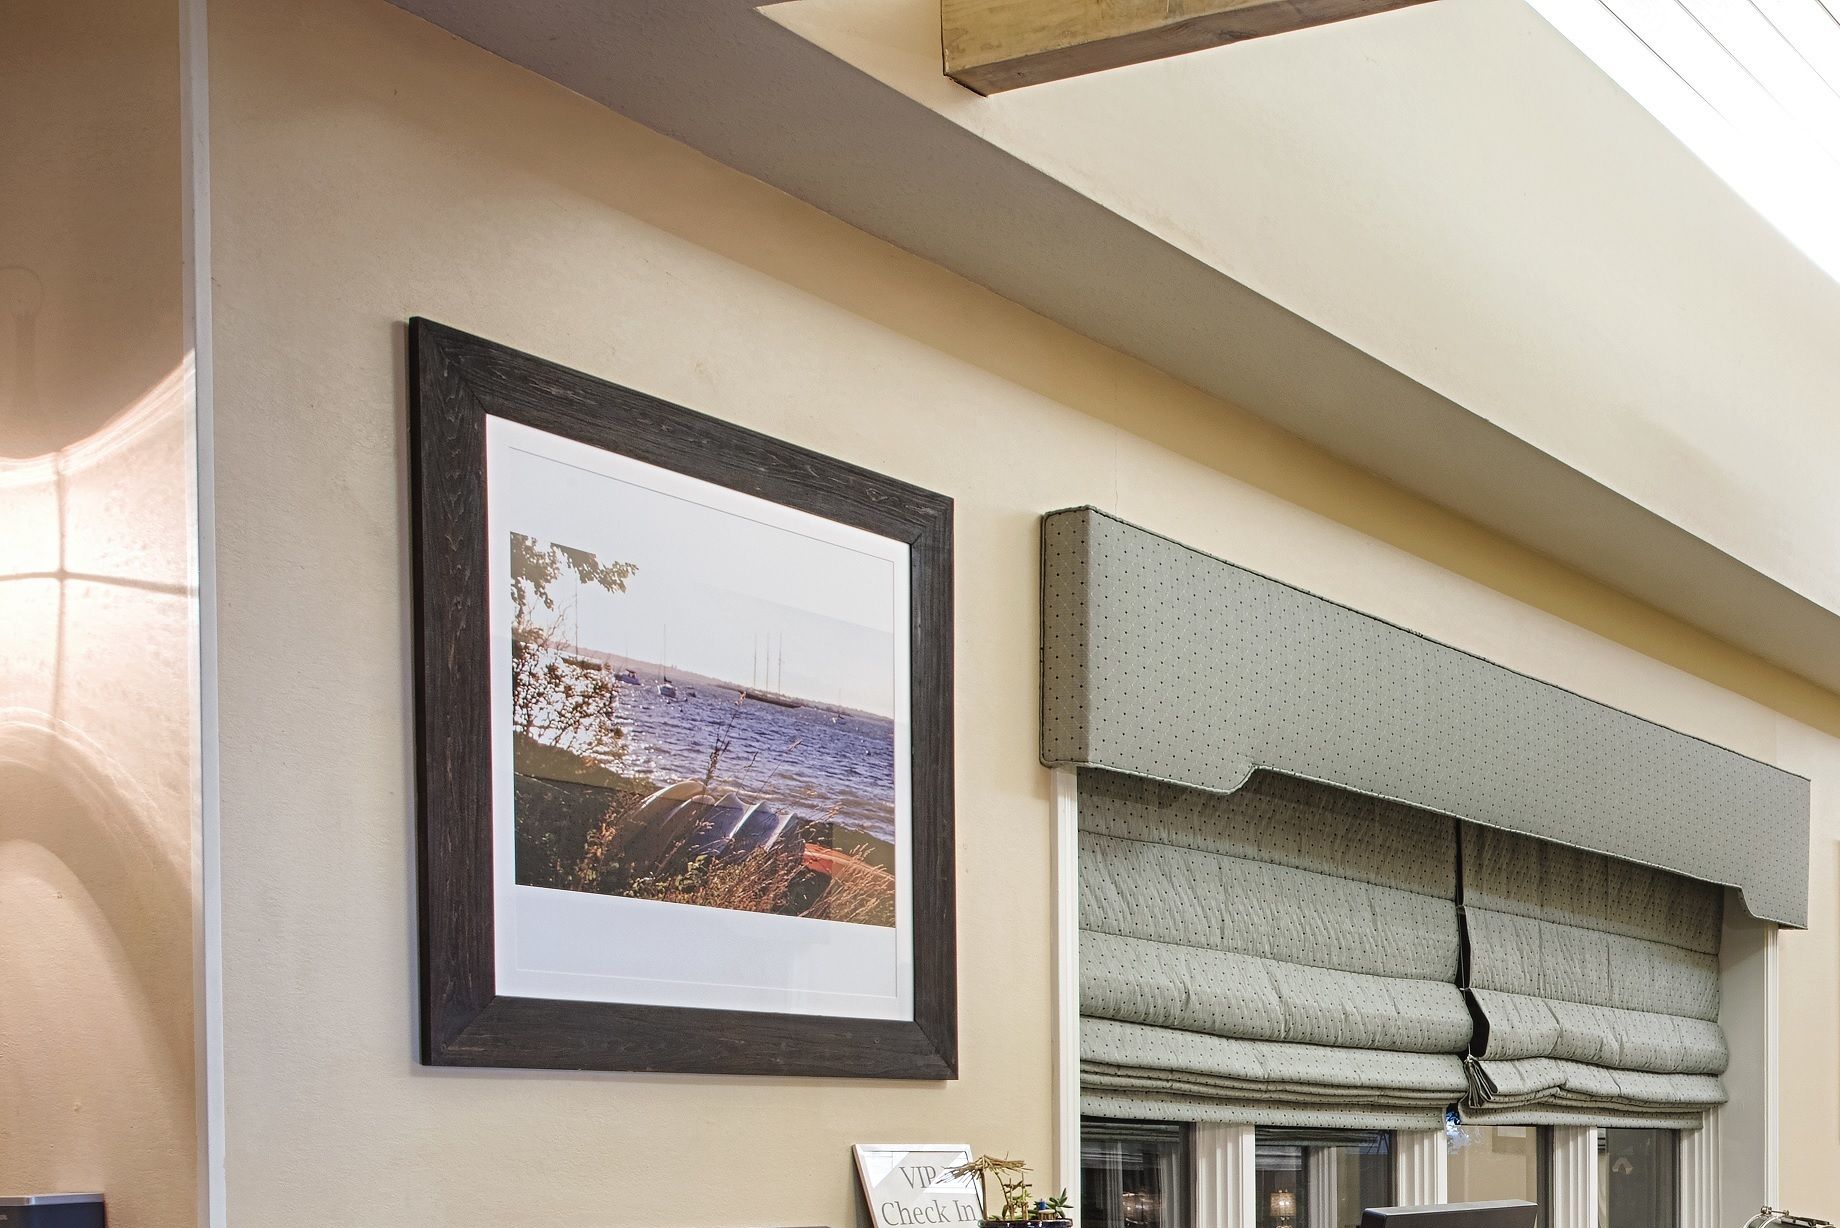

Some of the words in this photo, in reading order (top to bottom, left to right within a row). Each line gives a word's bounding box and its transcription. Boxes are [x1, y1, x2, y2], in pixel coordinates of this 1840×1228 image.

[899, 1165, 937, 1189] VIP
[881, 1199, 951, 1226] Check
[953, 1199, 977, 1222] In
